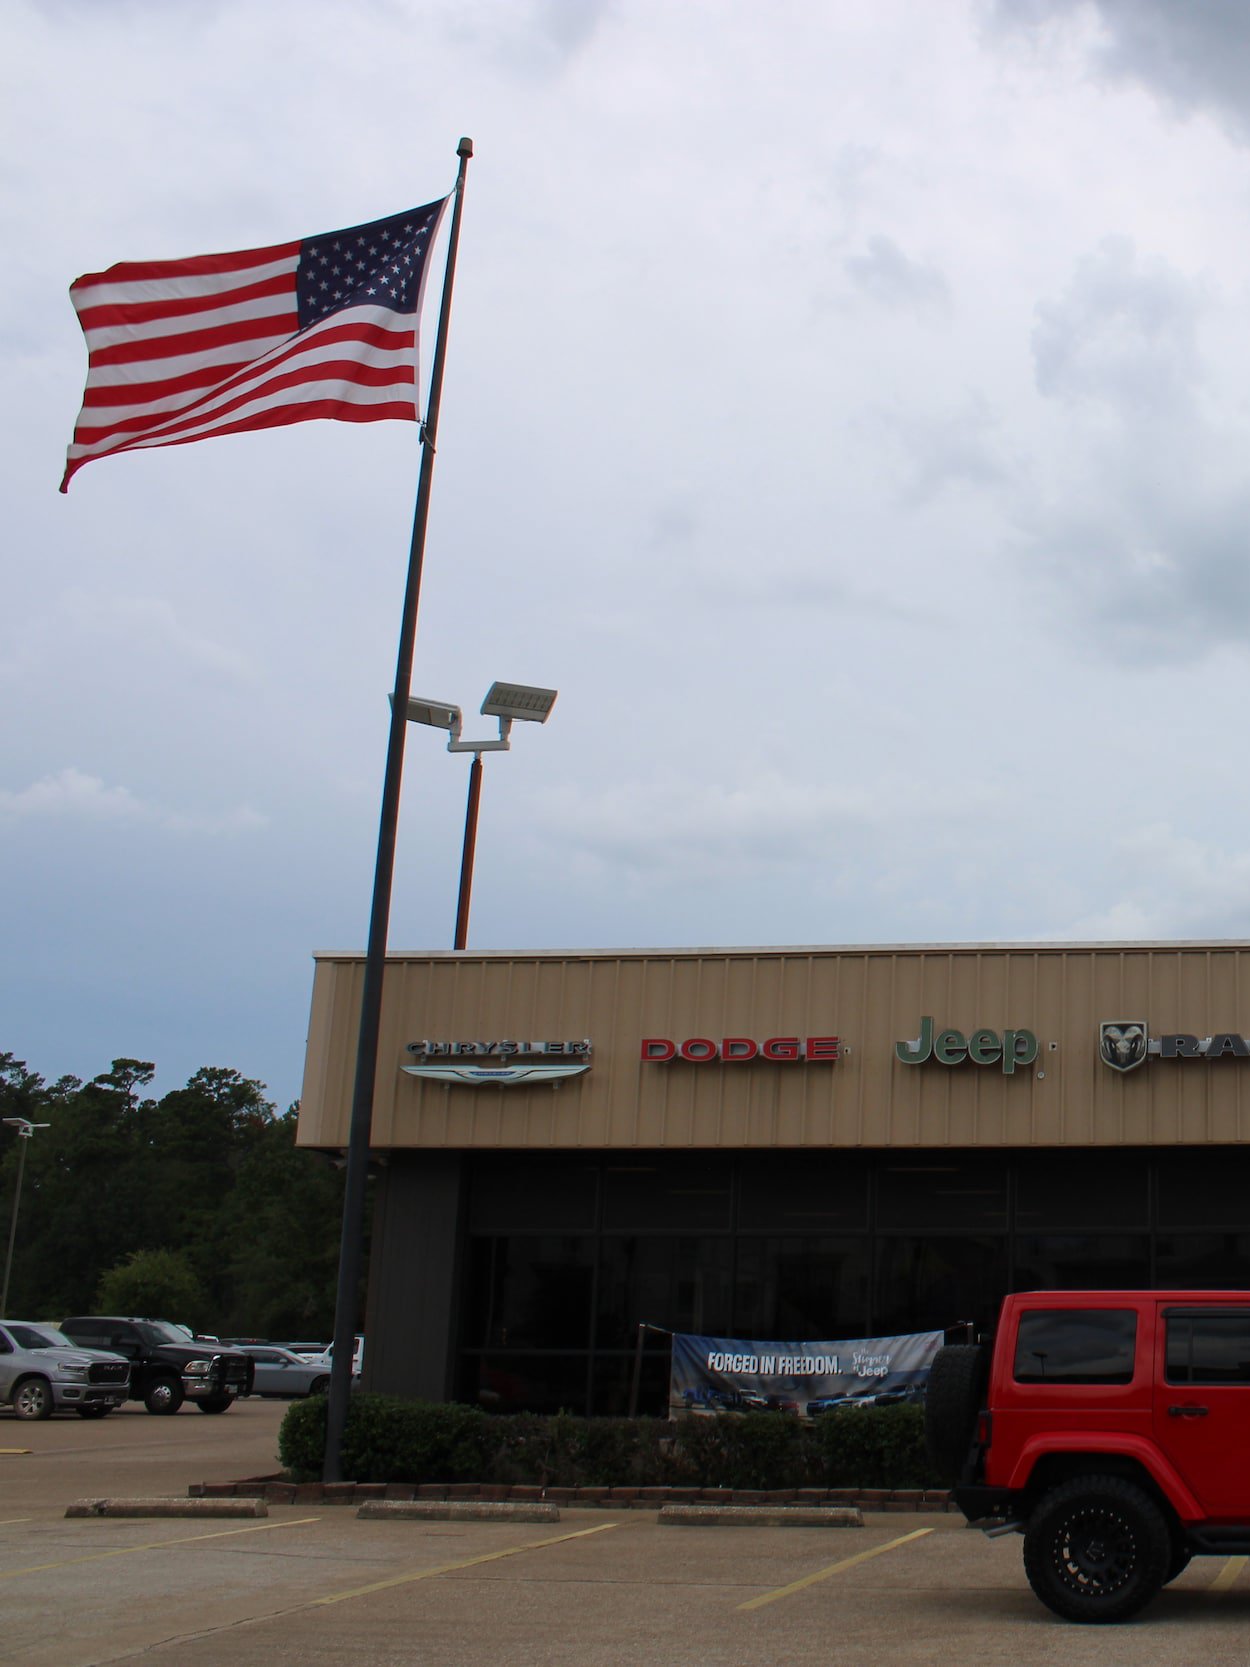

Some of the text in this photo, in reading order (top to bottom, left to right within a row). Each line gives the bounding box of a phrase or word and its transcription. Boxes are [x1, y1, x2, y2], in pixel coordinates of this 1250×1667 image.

[406, 1040, 591, 1056] CHRYSLER
[640, 1036, 840, 1062] DODGE
[896, 1016, 1039, 1075] Jeep
[708, 1351, 843, 1376] FORGED IN FREEDOM.
[858, 1365, 888, 1377] Jeep
